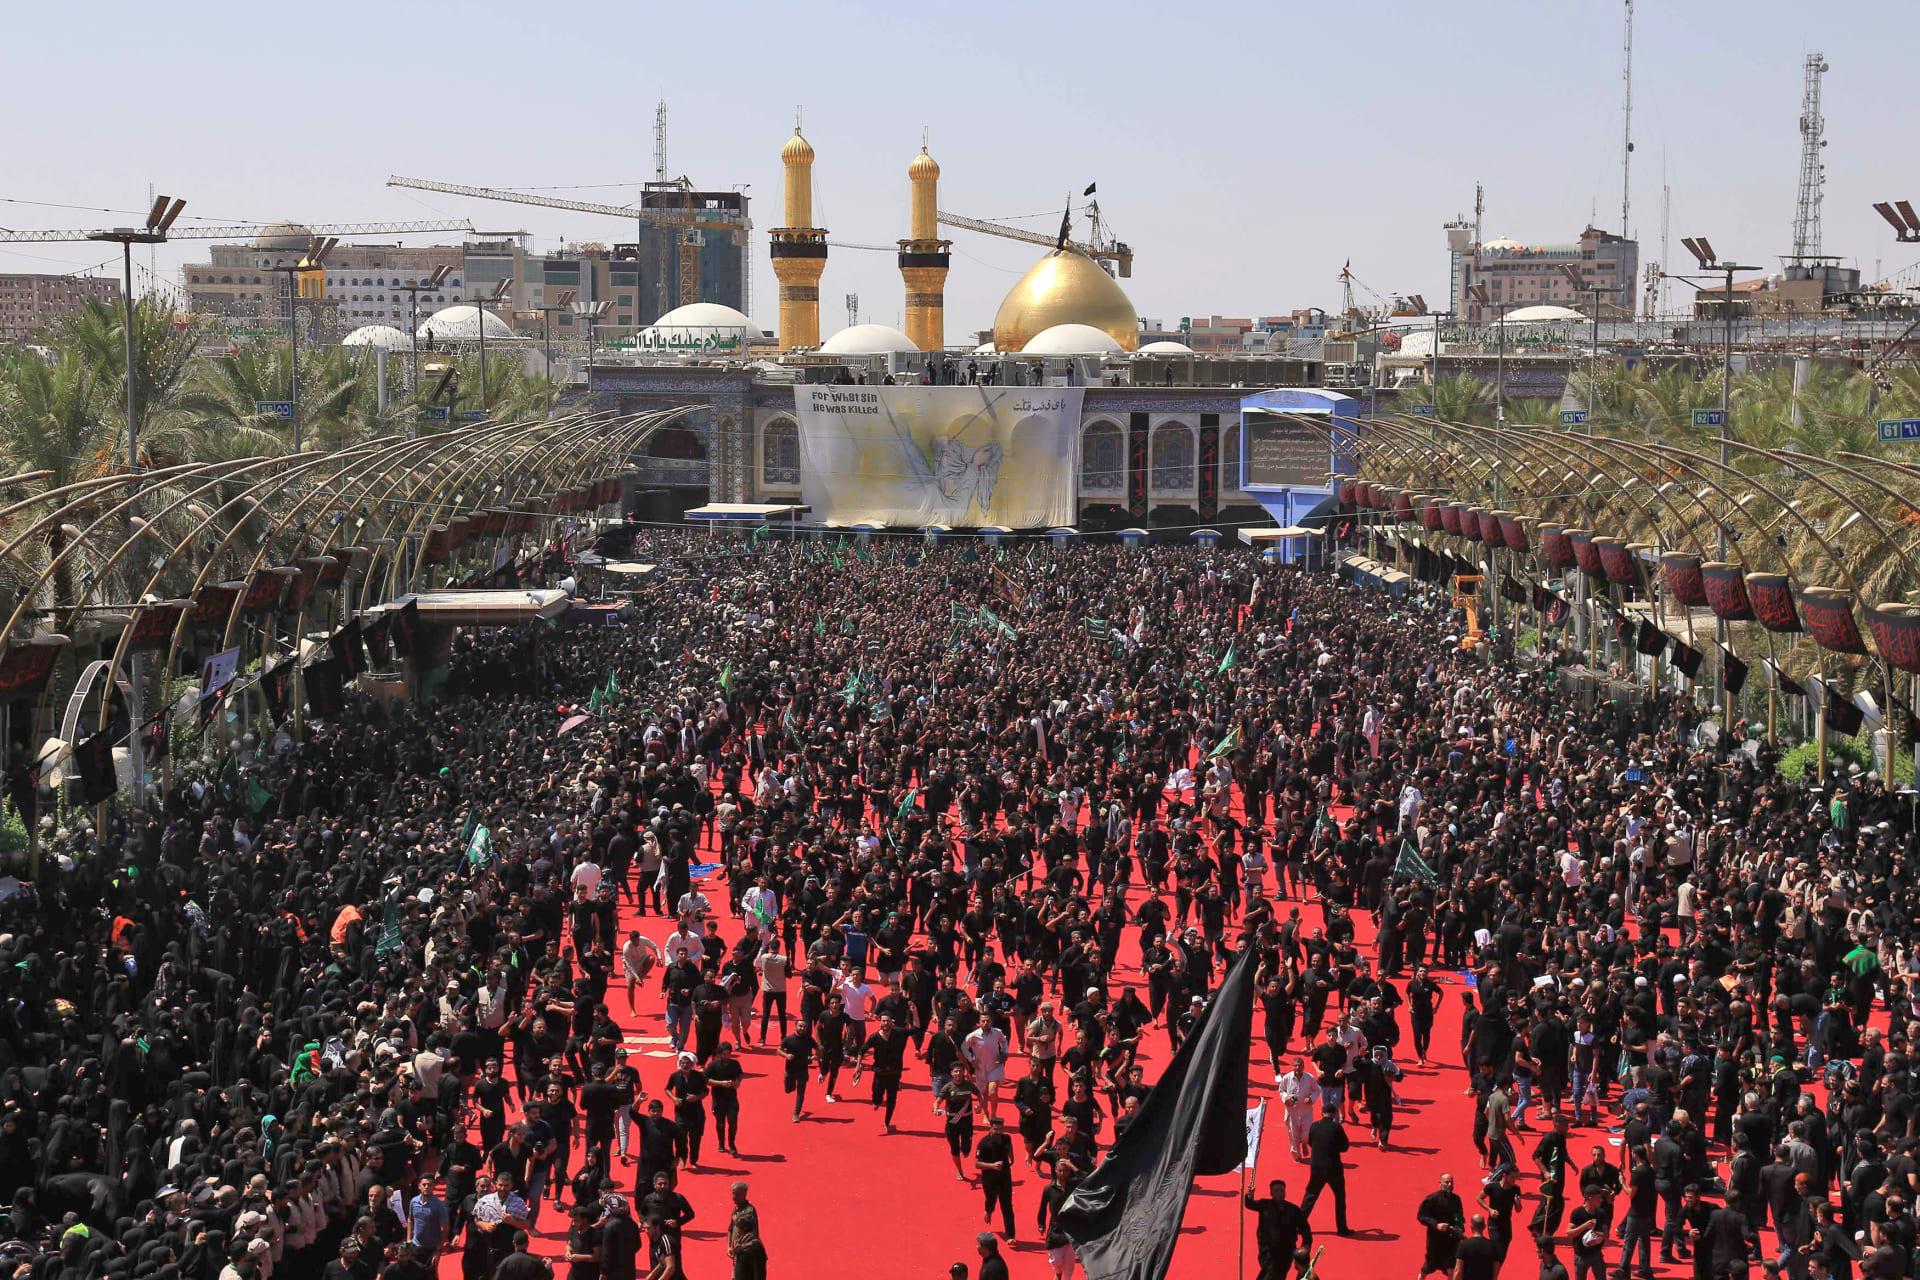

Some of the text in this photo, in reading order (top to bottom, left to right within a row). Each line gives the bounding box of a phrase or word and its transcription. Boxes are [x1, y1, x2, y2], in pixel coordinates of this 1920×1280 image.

[812, 391, 829, 401] For
[861, 393, 878, 402] Sin
[813, 403, 825, 412] He
[1013, 398, 1031, 411] قتلت
[1032, 400, 1051, 415] ذنب
[1563, 413, 1574, 423] 63
[1696, 413, 1707, 424] 62
[1884, 423, 1918, 437] 61 ٦١
